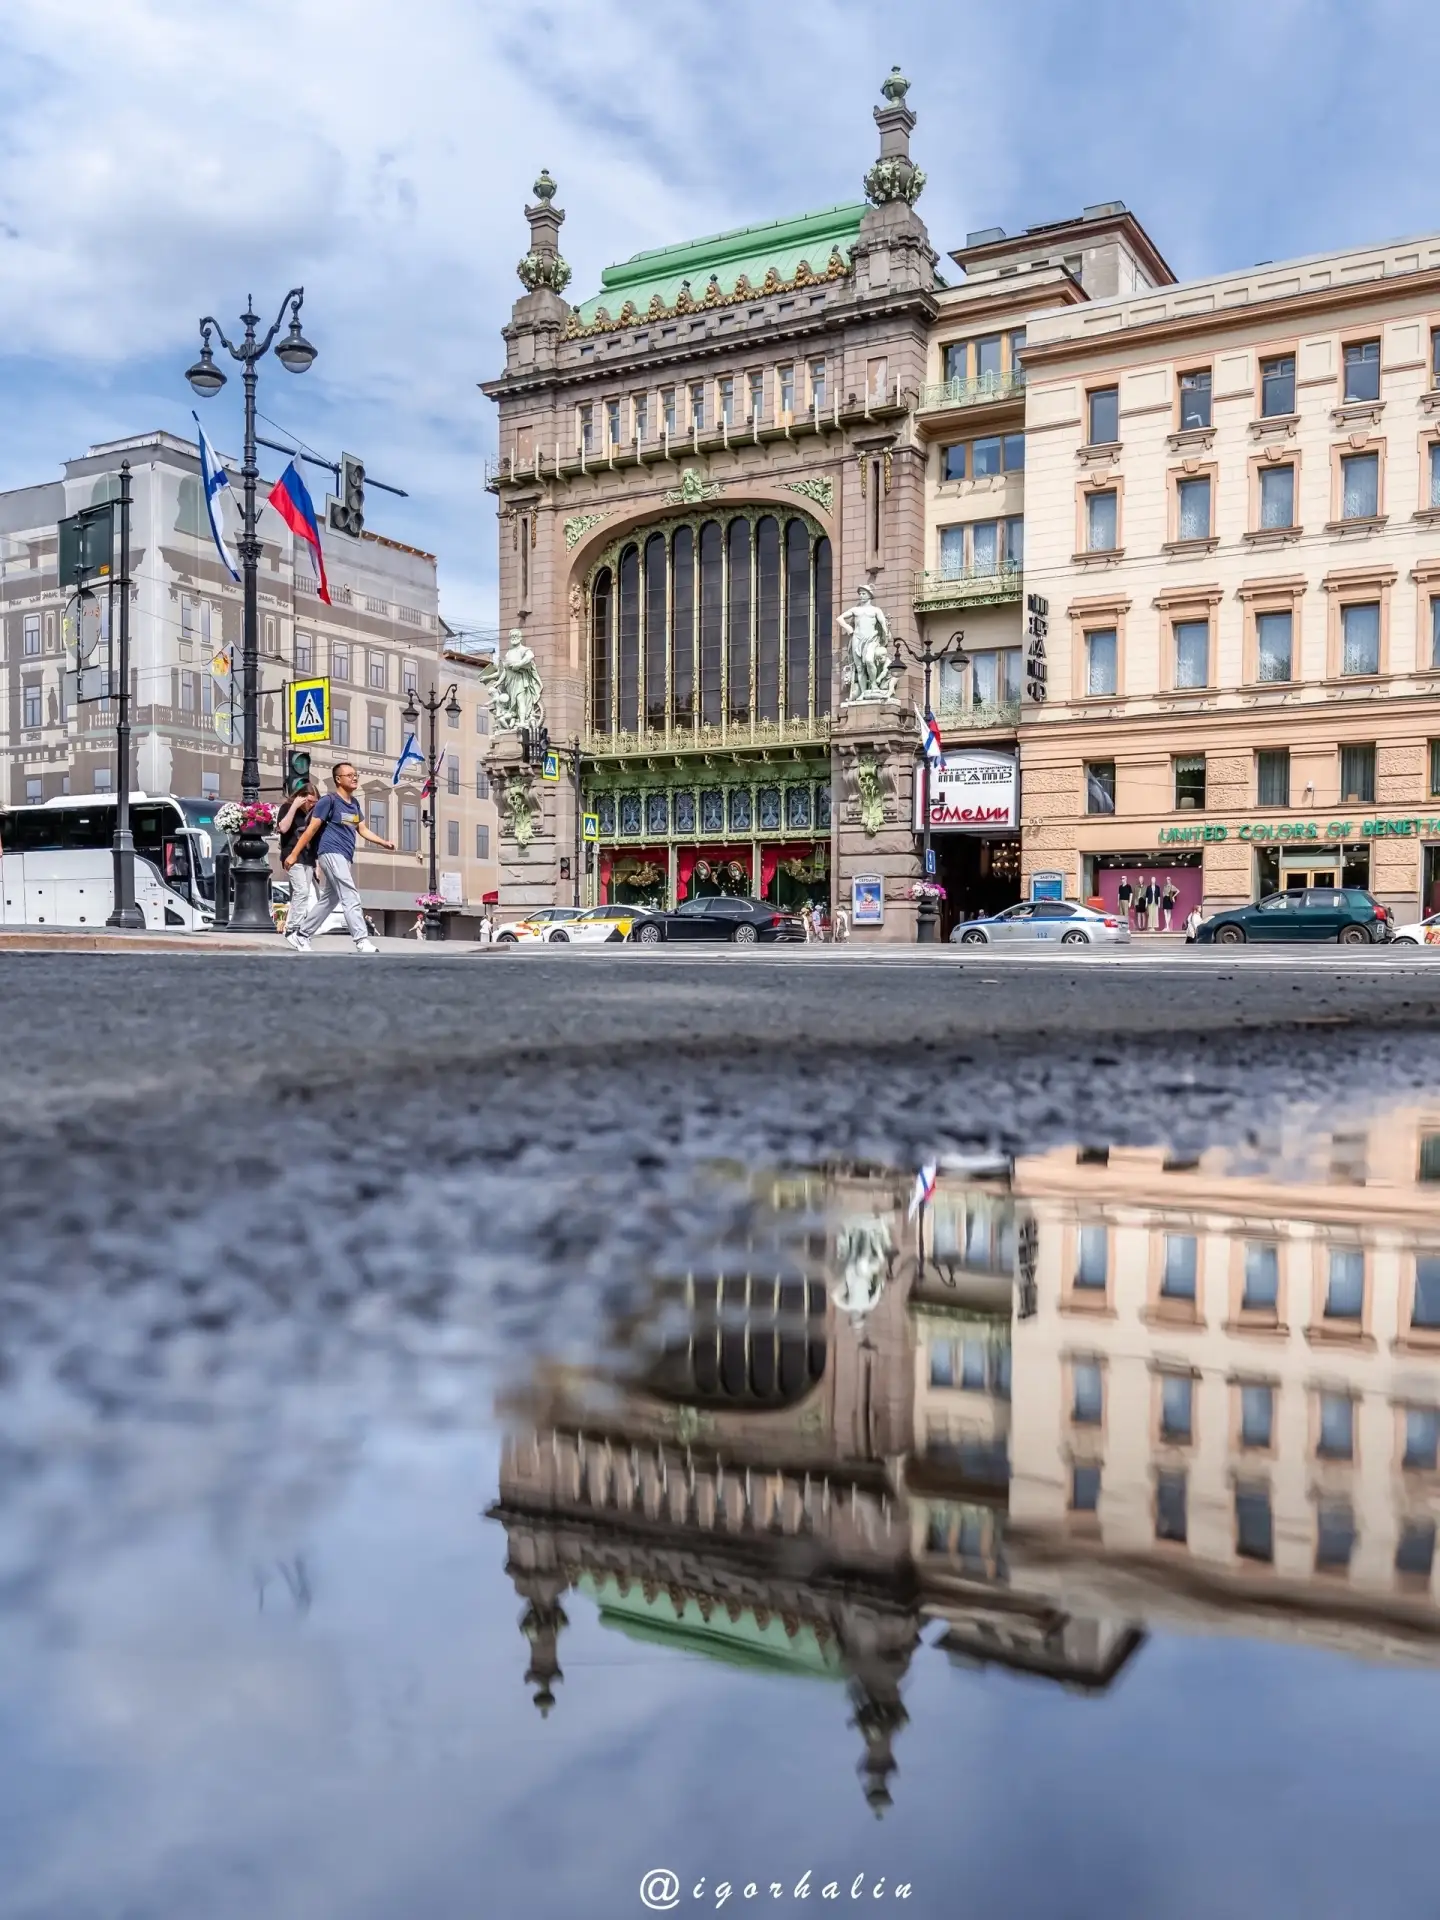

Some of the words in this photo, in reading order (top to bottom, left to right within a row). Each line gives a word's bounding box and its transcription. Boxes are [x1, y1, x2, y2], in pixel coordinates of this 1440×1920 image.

[1160, 824, 1228, 842] UNITED
[1239, 822, 1318, 840] COLORS
[1327, 821, 1353, 837] OF
